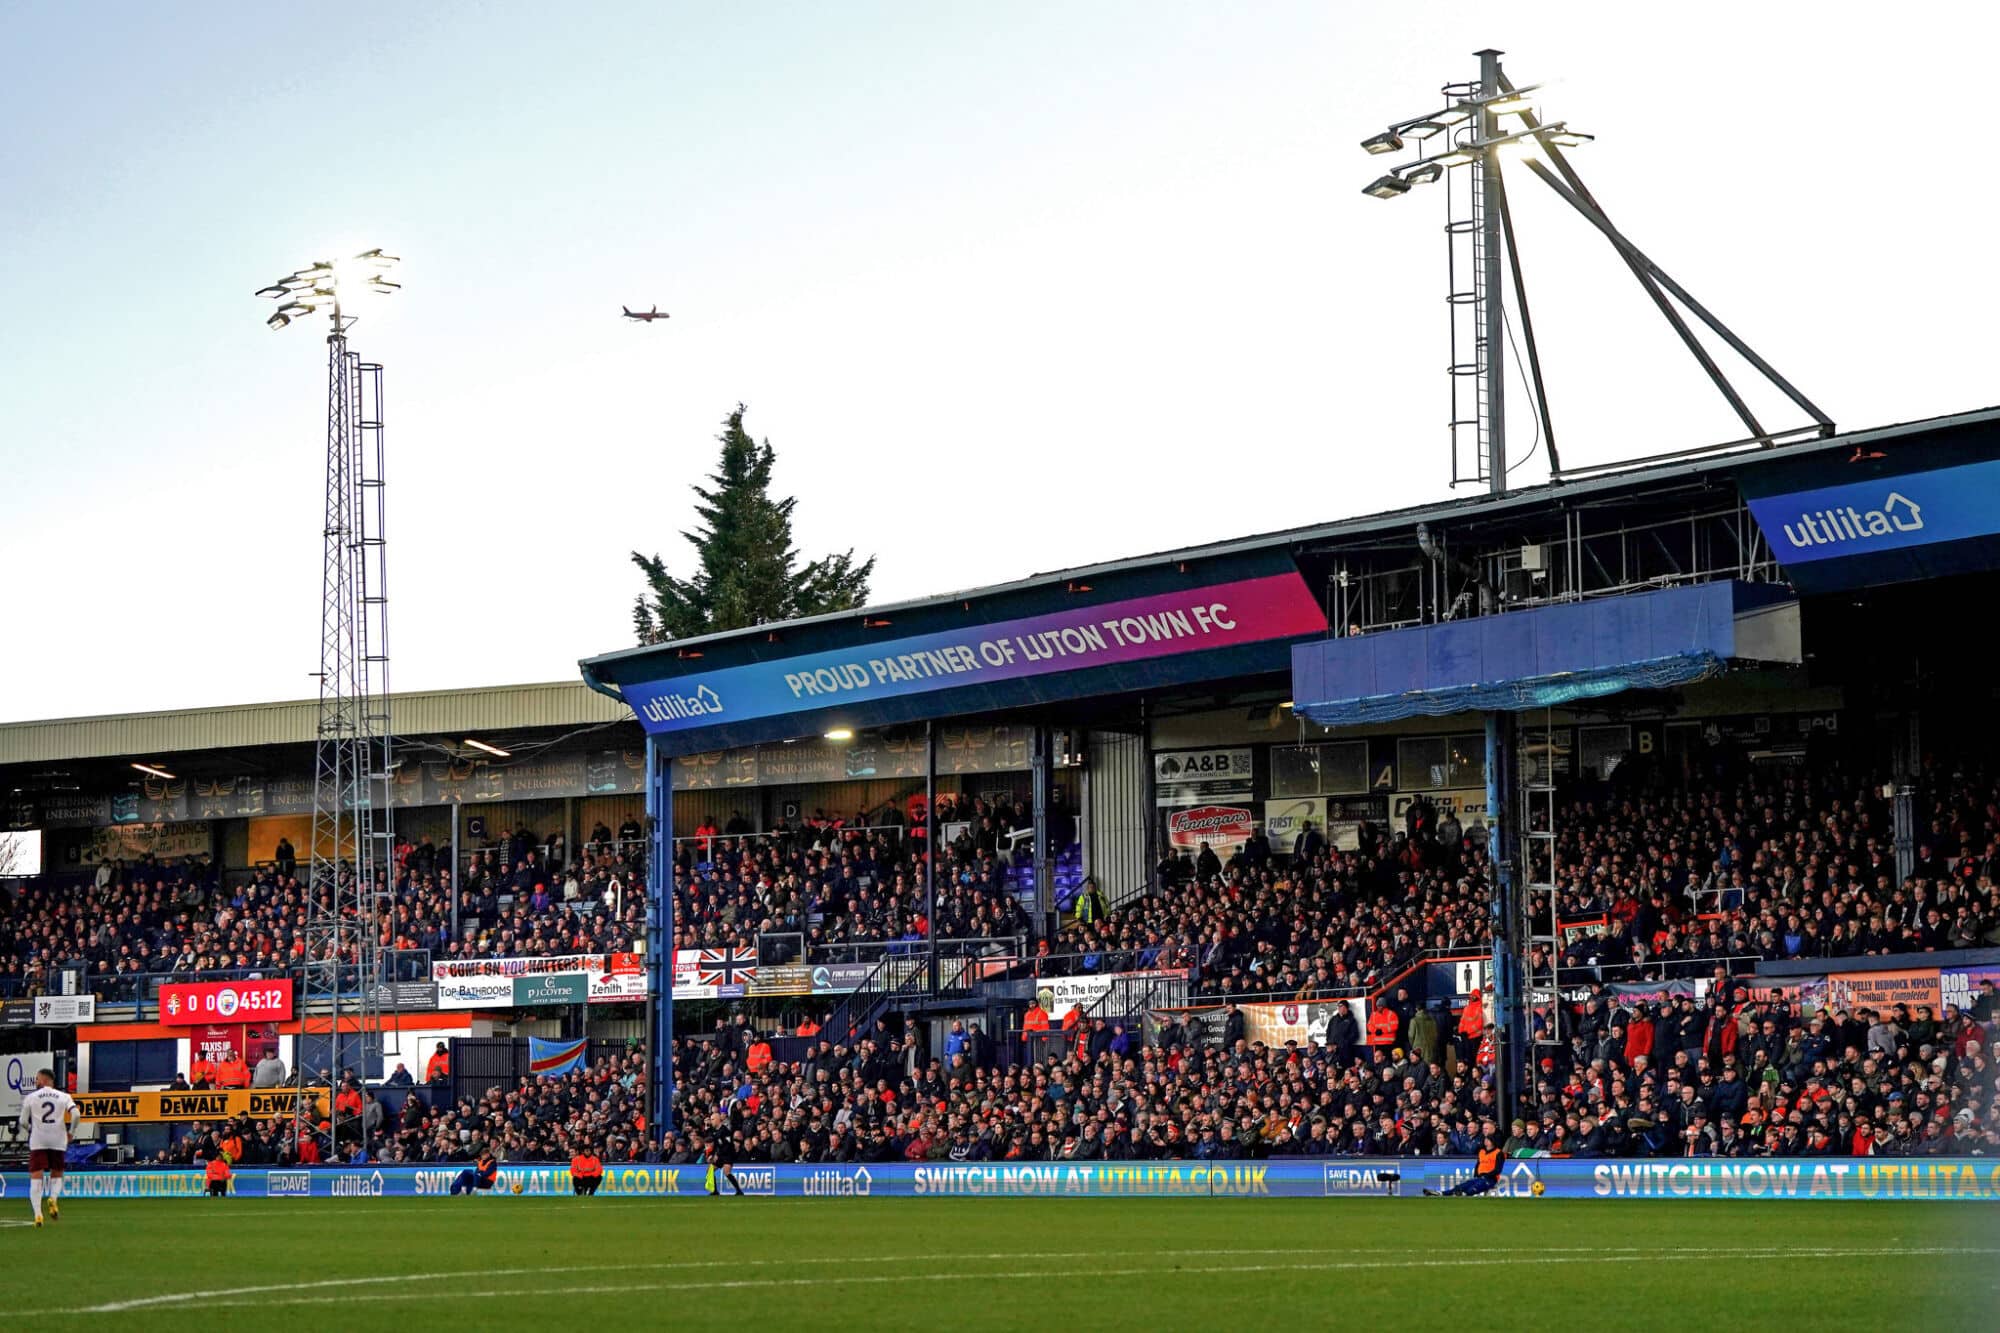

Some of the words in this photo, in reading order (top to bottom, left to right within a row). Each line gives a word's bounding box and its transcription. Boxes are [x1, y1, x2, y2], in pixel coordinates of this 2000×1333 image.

[1783, 507, 1893, 547] utilita
[784, 663, 871, 698] PROUD
[868, 646, 983, 683] PARTNER
[980, 639, 1022, 667] OF
[1016, 624, 1108, 662] LUTON
[1102, 609, 1195, 647] TOWN
[1192, 602, 1237, 633] FC
[642, 694, 706, 723] utilita
[1638, 731, 1653, 754] B
[1184, 755, 1229, 773] A&B
[1374, 765, 1393, 788] A
[786, 805, 798, 818] D
[470, 820, 481, 833] C
[1269, 816, 1294, 829] FIRST
[450, 962, 485, 977] COME
[484, 961, 501, 976] ON
[503, 961, 526, 975] YOU
[459, 985, 512, 996] BATHROOMS
[591, 983, 622, 995] Zenith
[1056, 985, 1069, 996] Oh
[1070, 984, 1086, 995] The
[1087, 983, 1110, 994] Irony
[1941, 973, 1969, 992] ROB
[188, 995, 197, 1011] 0
[206, 994, 215, 1011] 0
[239, 990, 282, 1009] 45:12
[1748, 985, 1801, 1002] LUTN'S
[200, 1041, 221, 1052] TAXIS
[194, 1052, 216, 1063] MRE
[41, 1101, 56, 1124] 2
[281, 1176, 308, 1191] DAVE
[528, 1169, 549, 1193] AT
[803, 1169, 853, 1196] utilita
[914, 1167, 998, 1193] SWITCH
[1003, 1167, 1058, 1193] NOW
[1064, 1167, 1093, 1193] AT
[1099, 1166, 1269, 1194] UTILITA.CO.UK
[1329, 1170, 1348, 1178] SAVE
[1594, 1164, 1711, 1196] SWITCH
[1720, 1164, 1800, 1196] NOW
[1809, 1164, 1849, 1196] AT
[84, 1175, 118, 1195] NOW
[119, 1175, 137, 1195] AT
[331, 1175, 370, 1196] utilita
